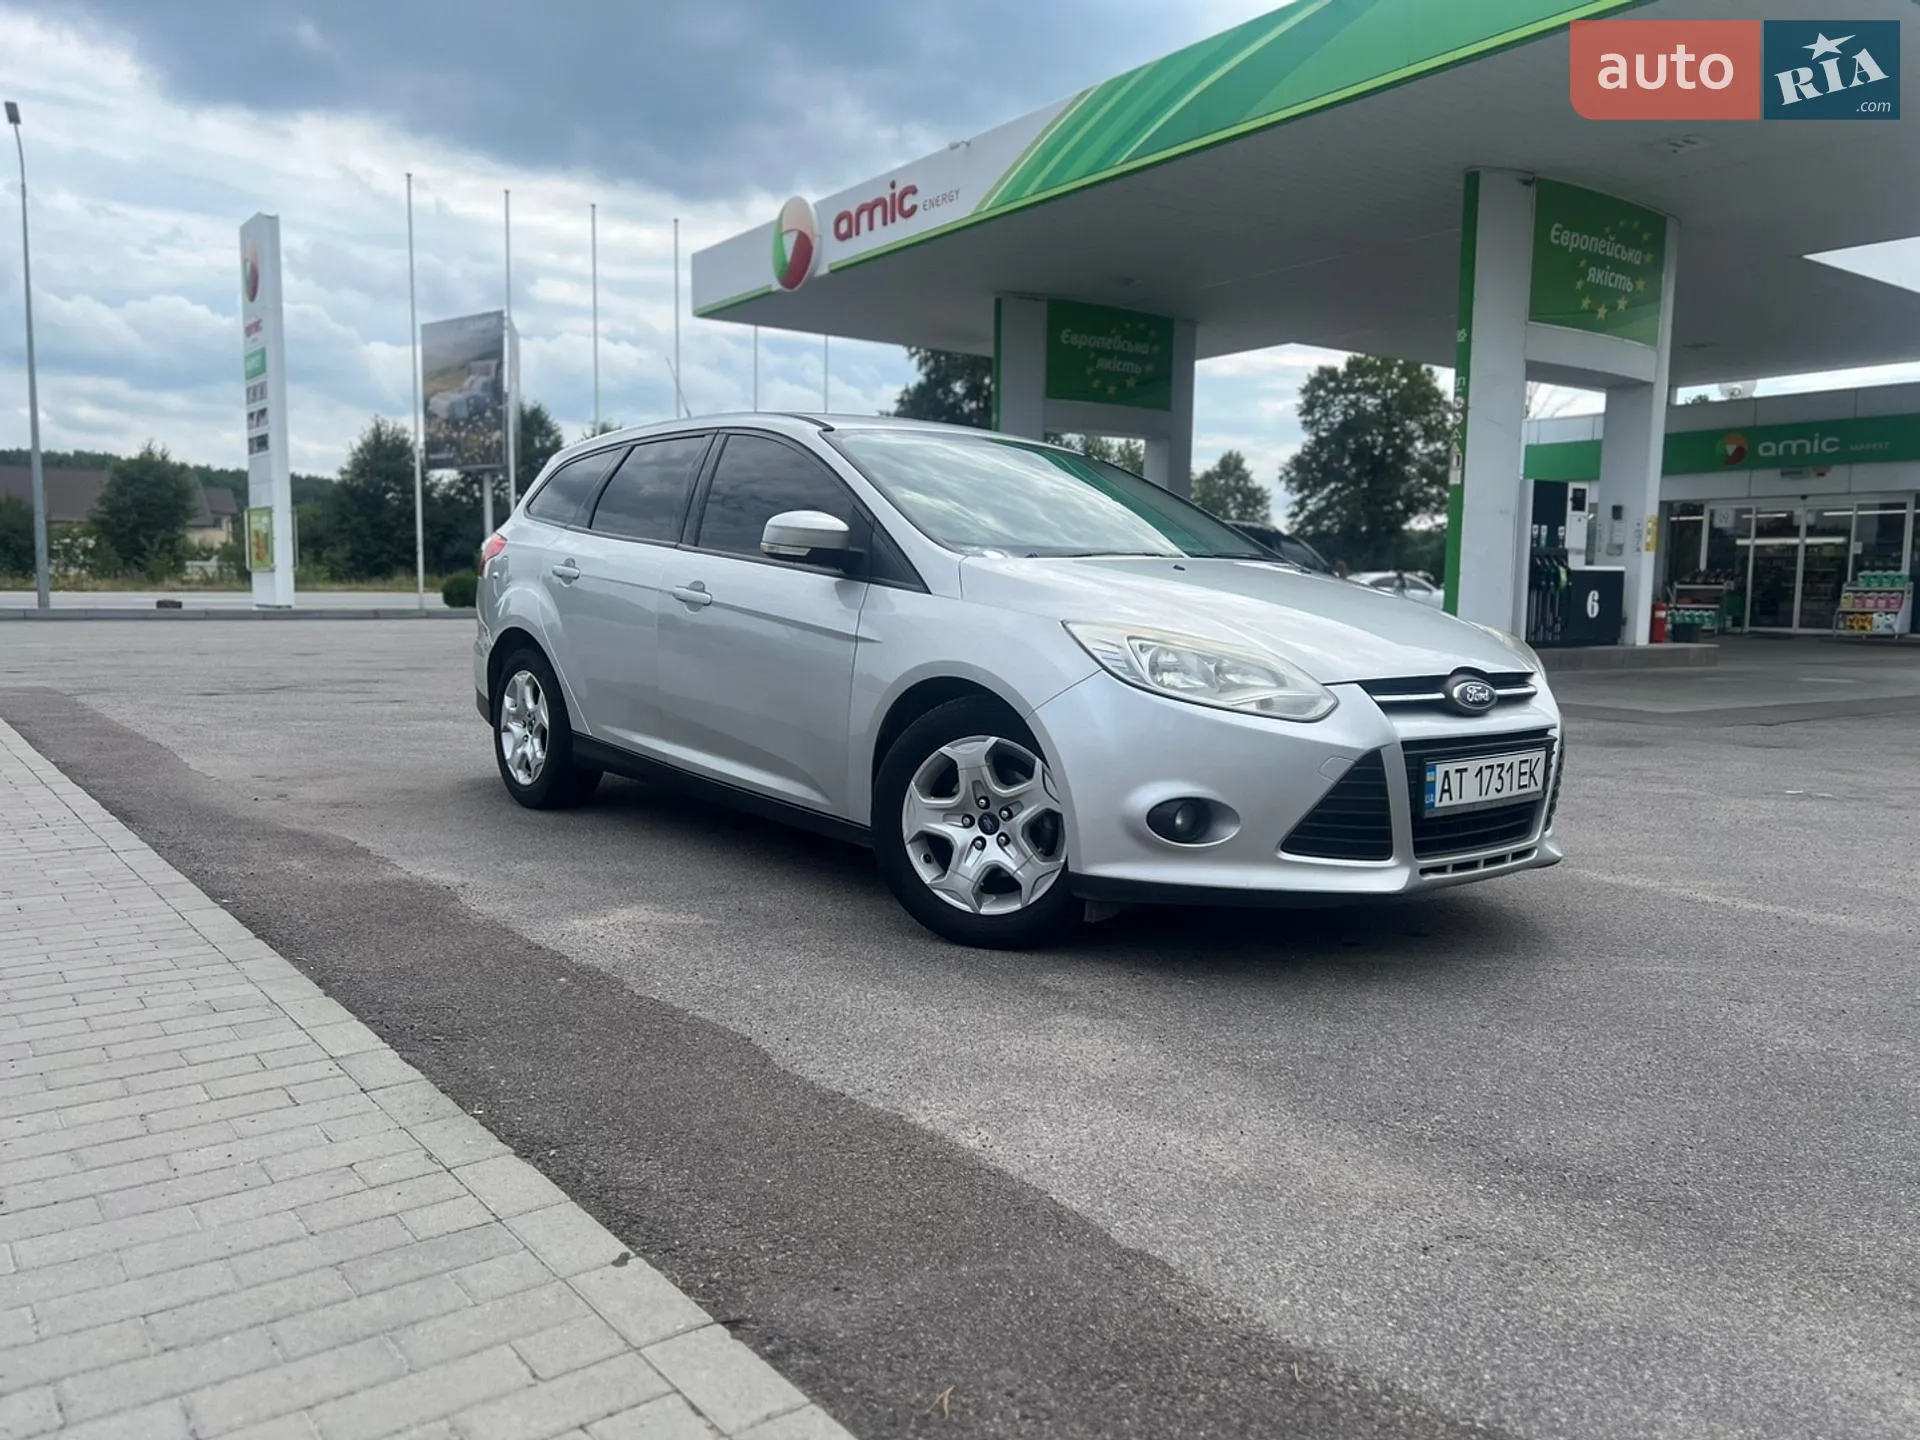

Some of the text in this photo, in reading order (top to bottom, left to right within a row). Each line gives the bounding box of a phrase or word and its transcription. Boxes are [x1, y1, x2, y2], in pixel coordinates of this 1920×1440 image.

[833, 180, 961, 242] amic ENERGY
[1550, 222, 1642, 265] Європейська
[1586, 265, 1634, 292] якість
[1060, 328, 1149, 355] Європейська
[1096, 356, 1142, 375] якість
[1757, 432, 1841, 457] amic
[1586, 590, 1600, 618] 6
[1466, 685, 1489, 702] Ford
[1438, 757, 1541, 803] AT 1731 EK
